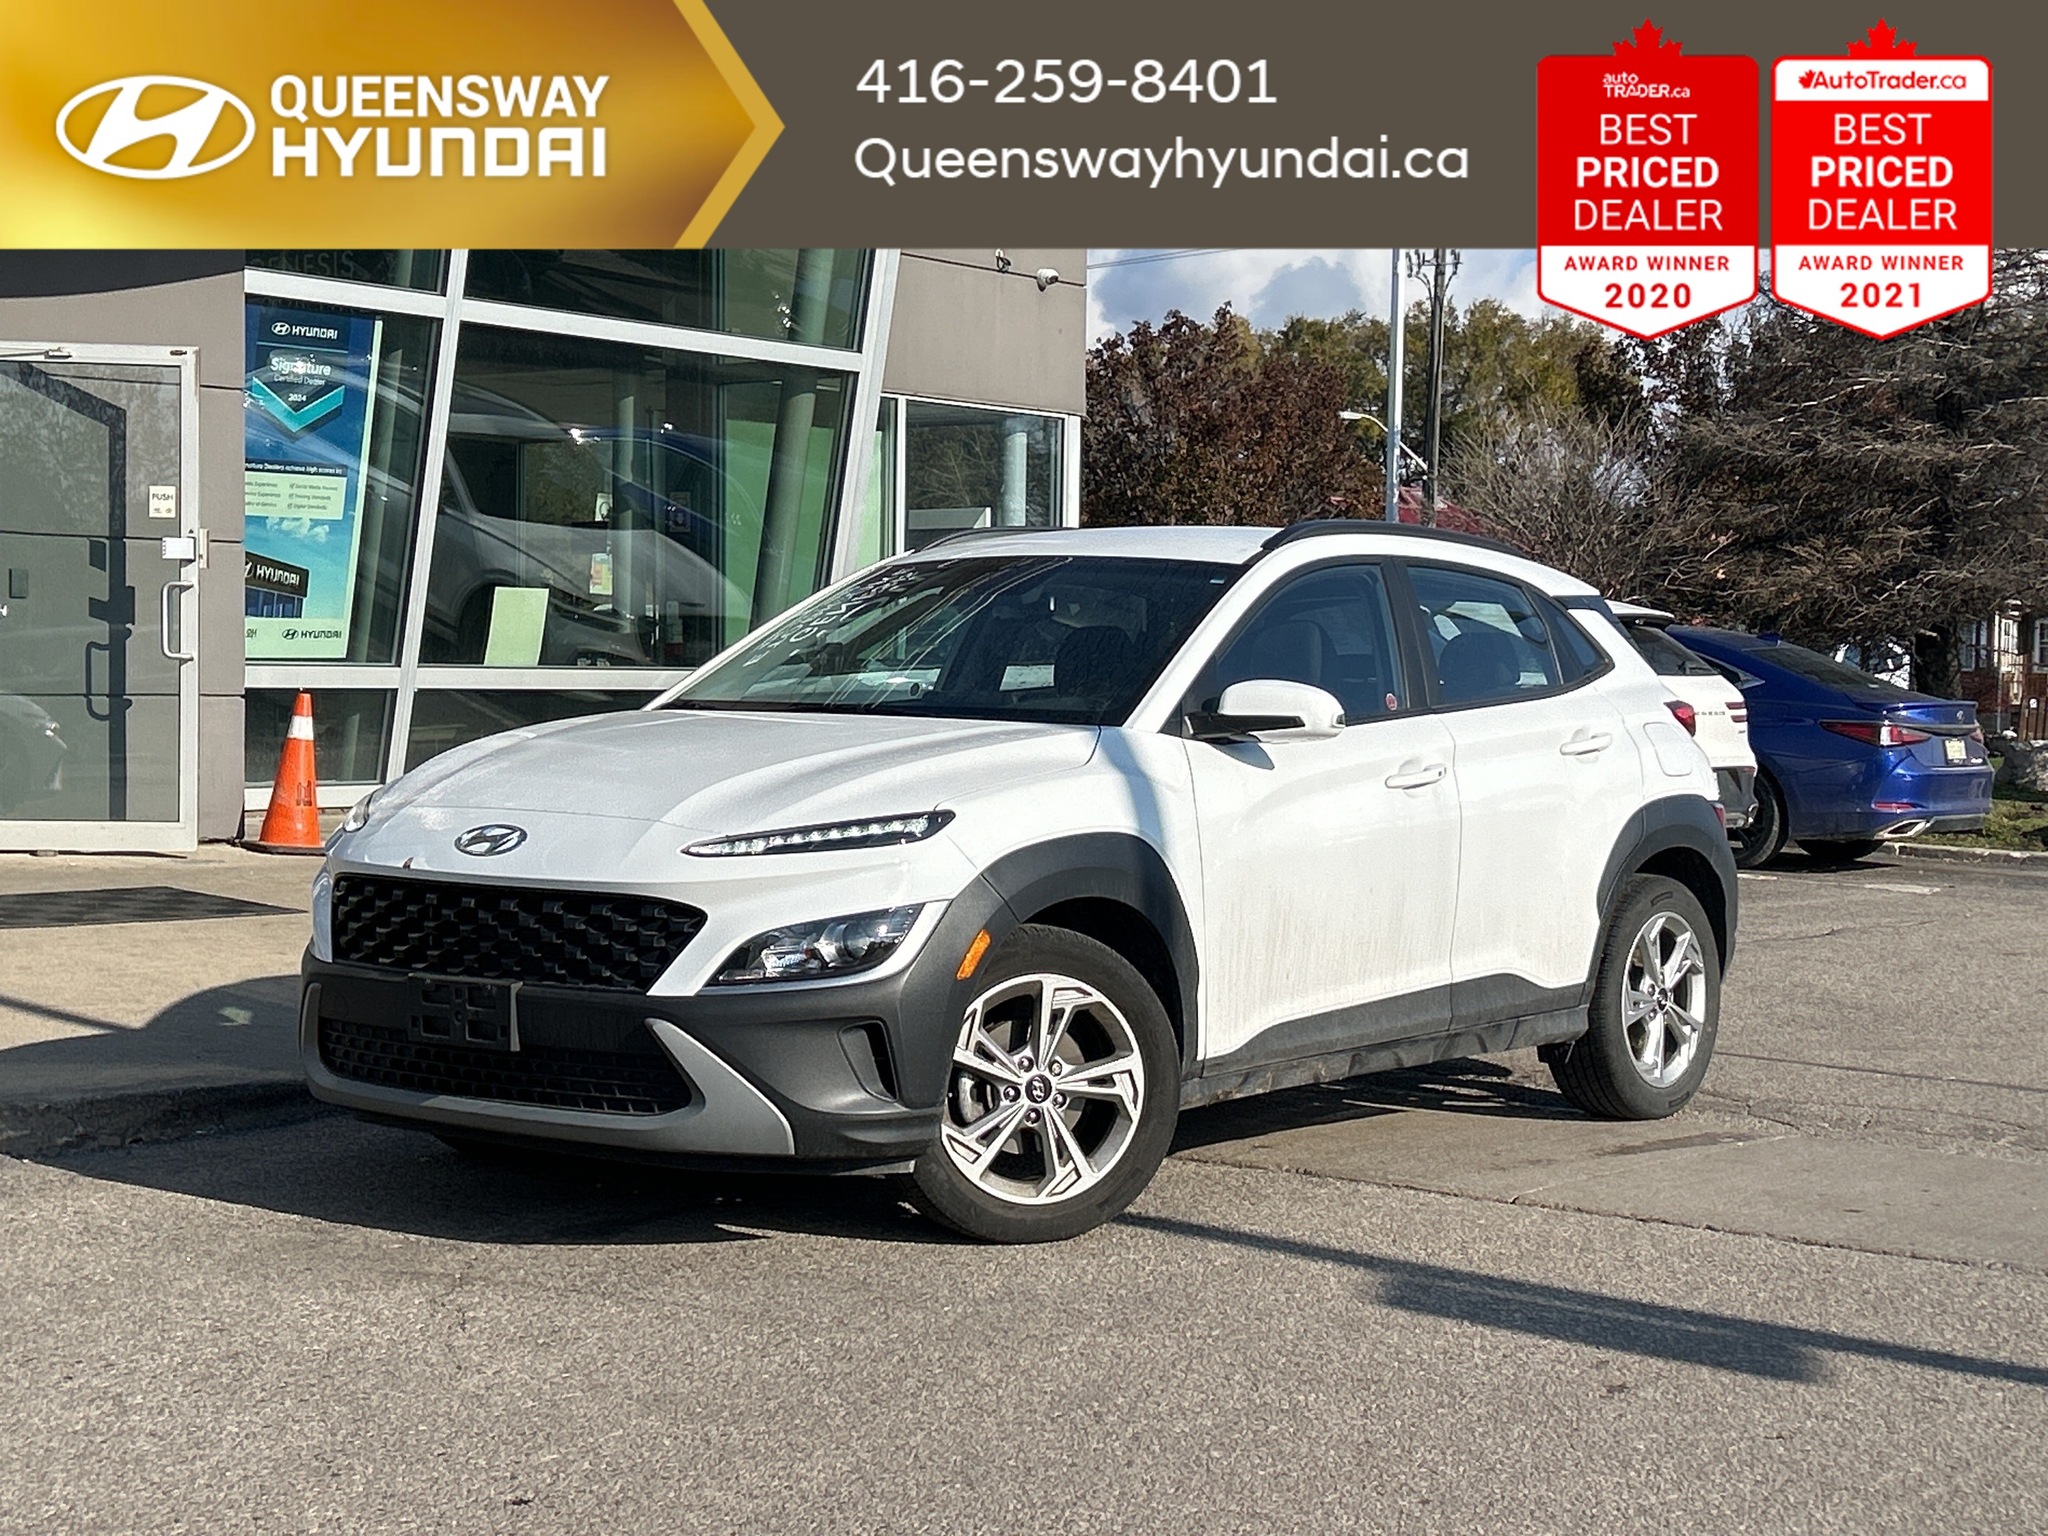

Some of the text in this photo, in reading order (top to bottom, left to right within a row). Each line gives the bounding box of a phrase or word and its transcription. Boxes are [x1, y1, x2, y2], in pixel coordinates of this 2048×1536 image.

[292, 325, 338, 339] HYUNDAI
[152, 493, 174, 501] PUSH
[256, 564, 300, 586] HYUNDAI
[301, 630, 342, 639] HYUNDAI
